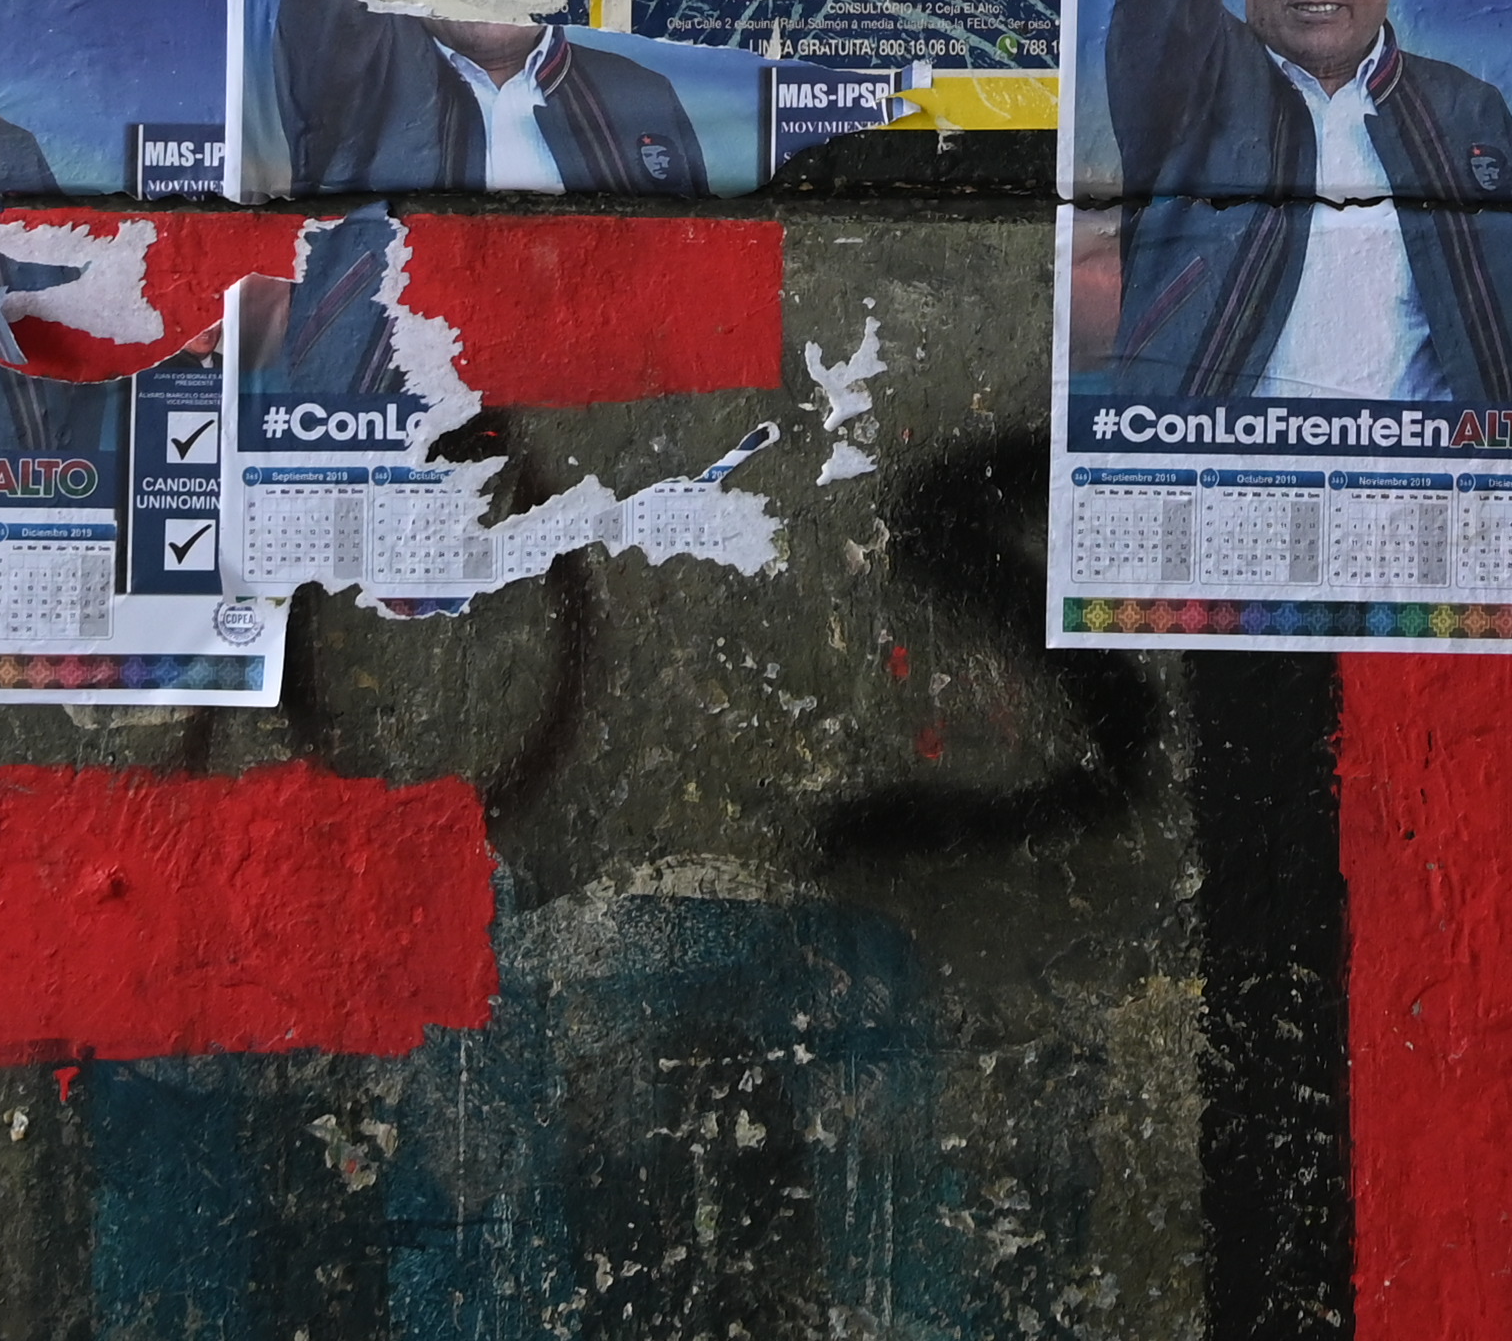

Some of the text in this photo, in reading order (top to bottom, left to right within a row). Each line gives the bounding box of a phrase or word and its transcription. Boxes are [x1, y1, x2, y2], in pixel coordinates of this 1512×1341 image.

[878, 40, 905, 56] 800
[909, 40, 924, 56] 16
[927, 41, 945, 56] 06
[948, 41, 966, 56] 06
